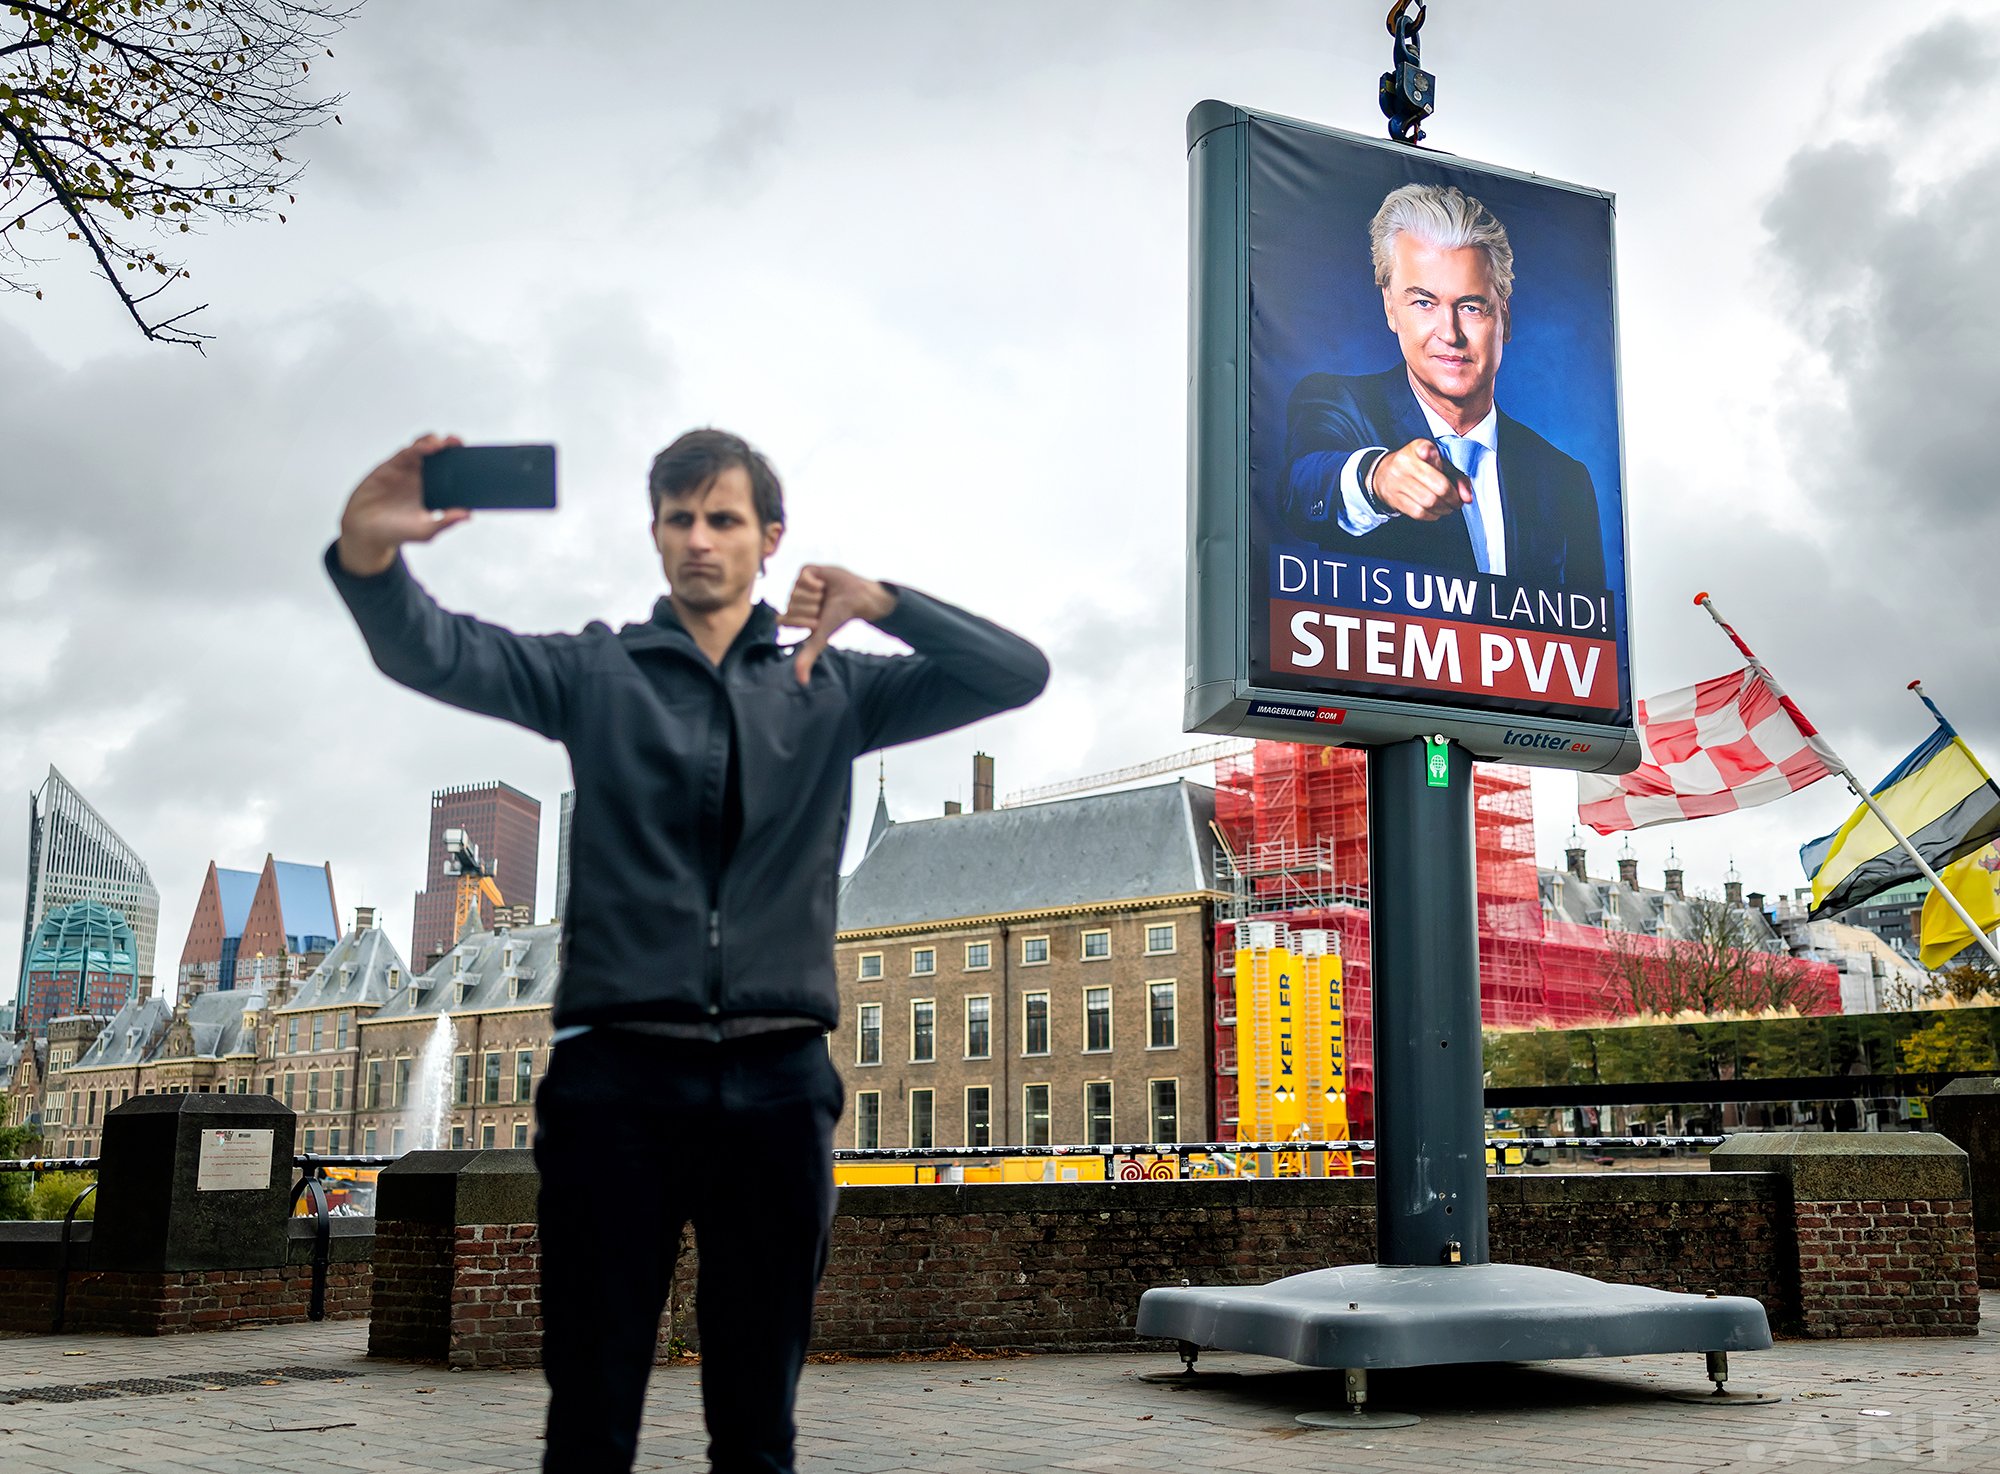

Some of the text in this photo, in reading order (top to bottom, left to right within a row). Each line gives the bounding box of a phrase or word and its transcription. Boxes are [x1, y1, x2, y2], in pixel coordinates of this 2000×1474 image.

[1278, 554, 1606, 633] DIT IS UW LAND!
[1290, 611, 1600, 698] STEM PVV
[1503, 729, 1591, 753] trotter.eu
[1280, 974, 1293, 1075] KELLER
[1330, 979, 1343, 1077] KELLER
